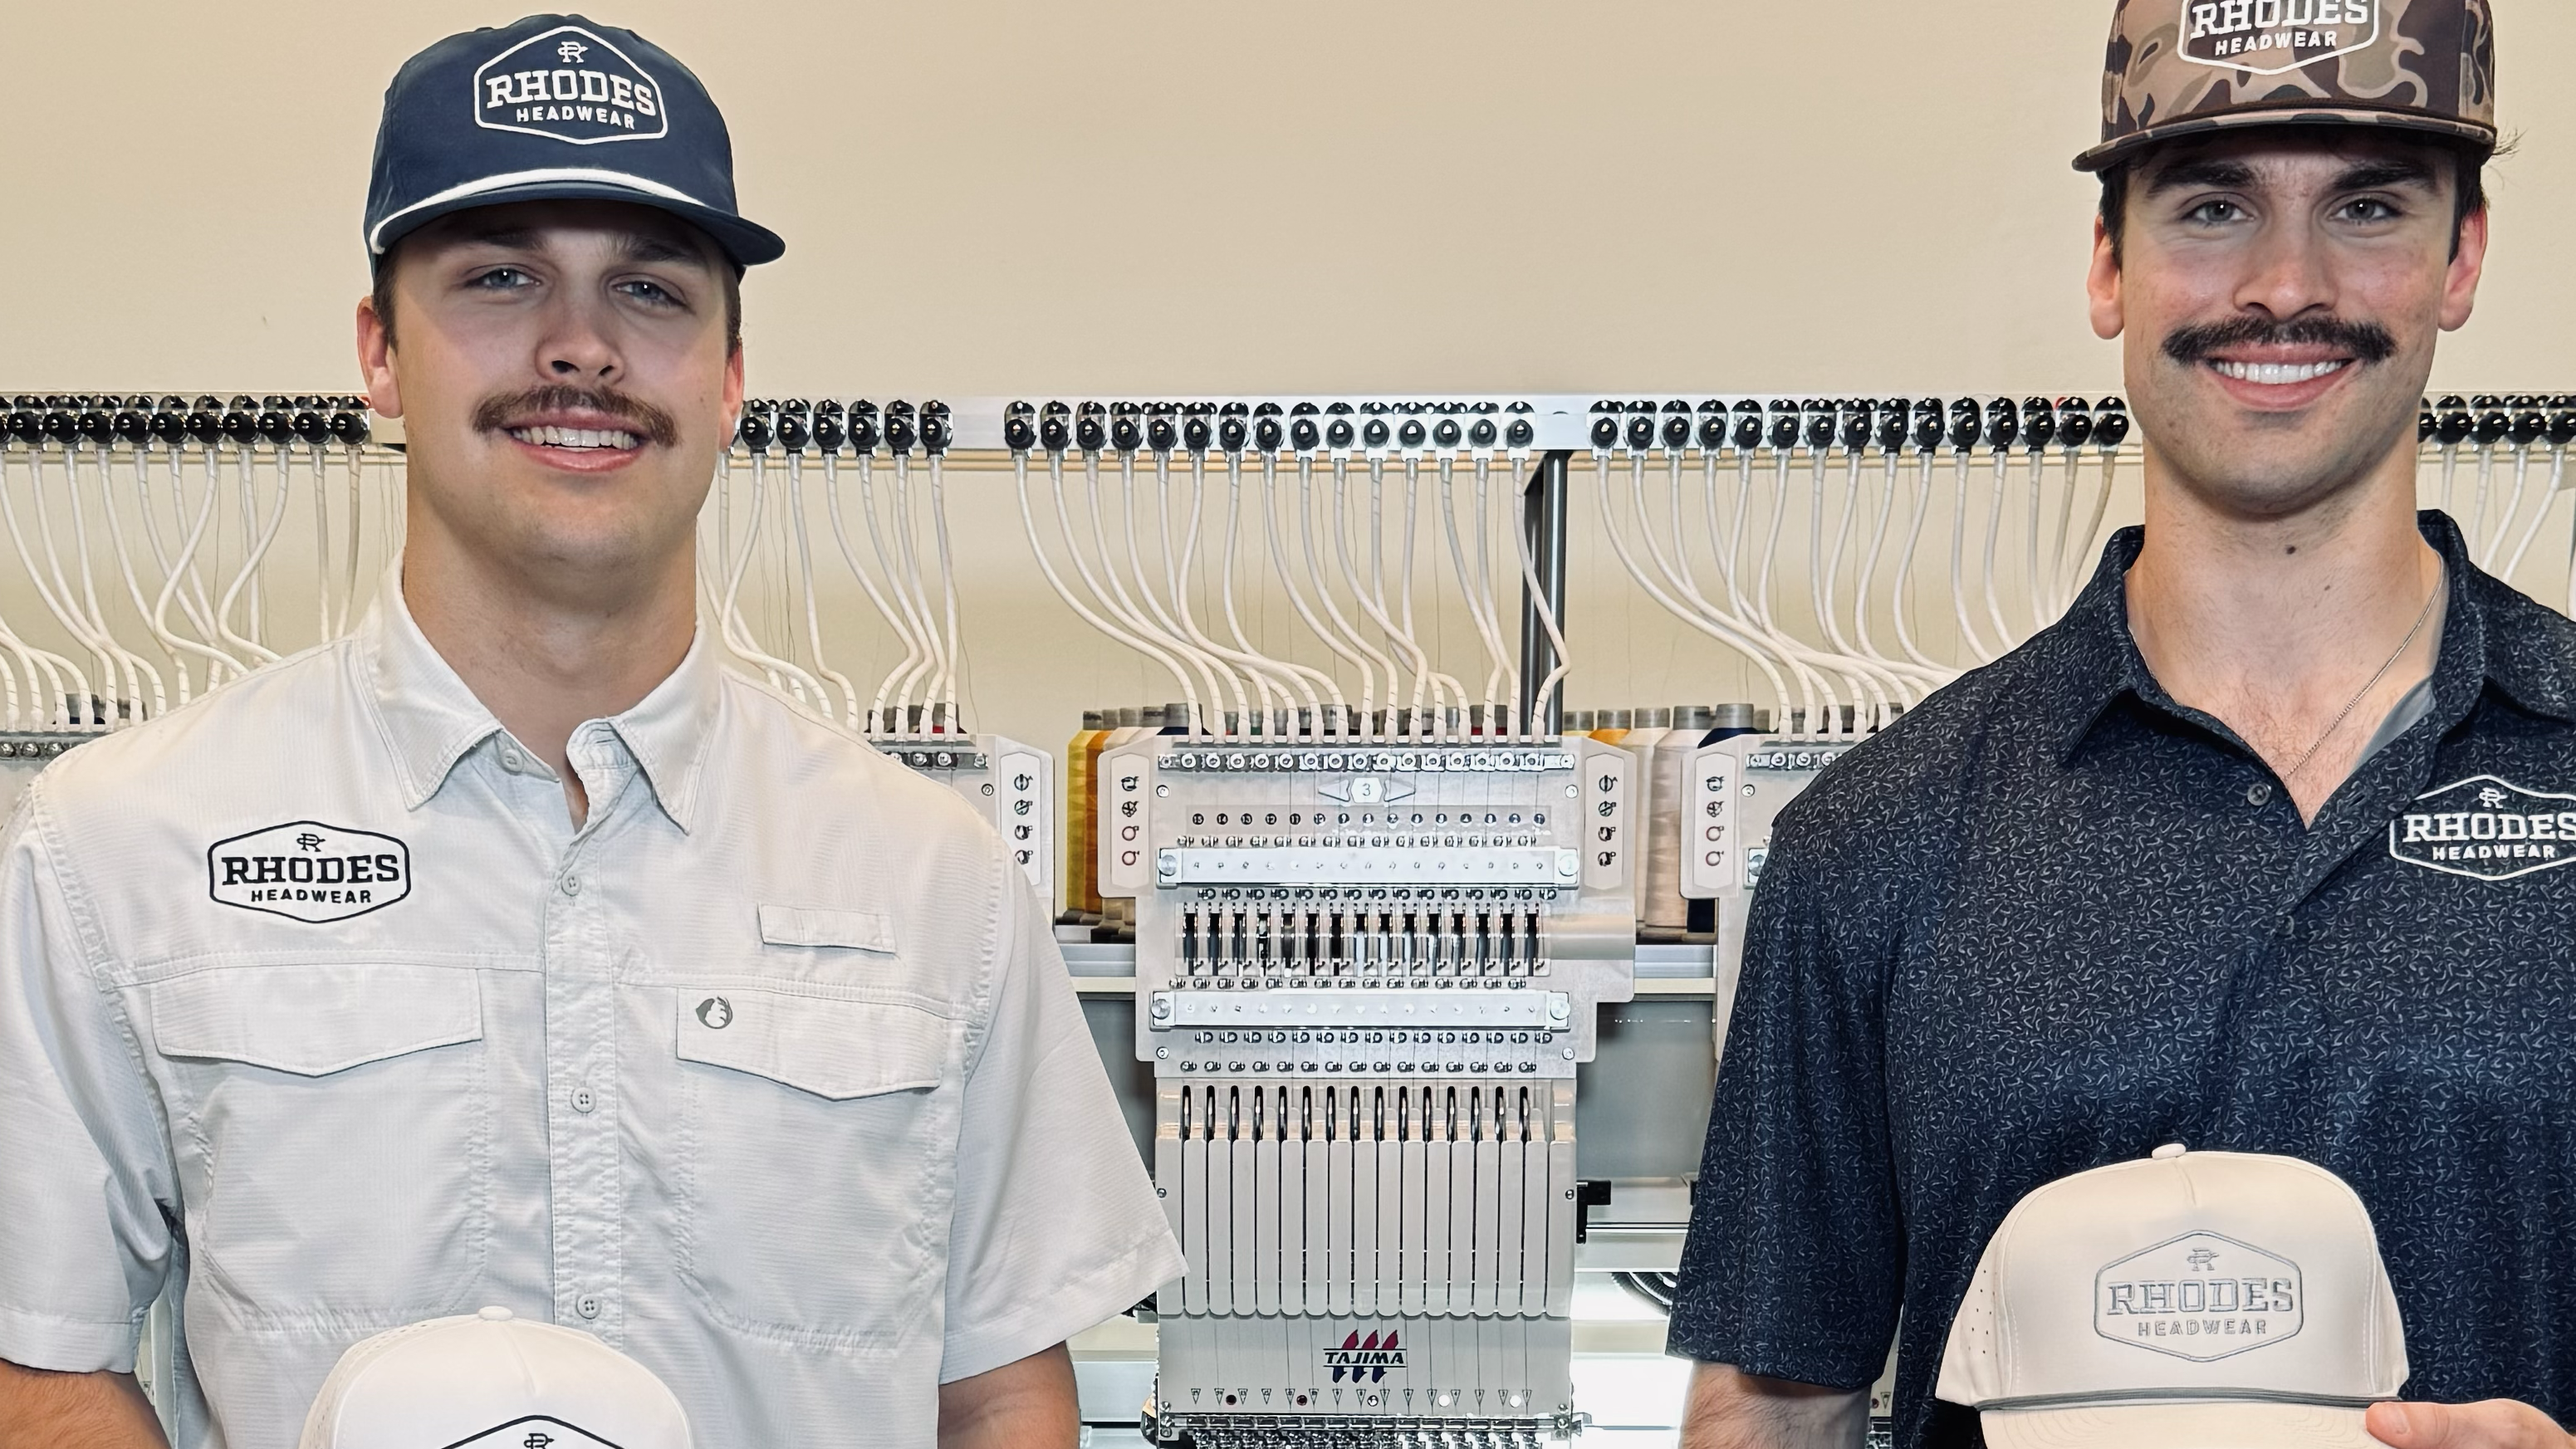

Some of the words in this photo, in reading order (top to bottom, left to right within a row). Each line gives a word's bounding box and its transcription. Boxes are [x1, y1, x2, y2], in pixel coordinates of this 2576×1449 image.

[2190, 0, 2368, 39] RHODES
[2215, 30, 2338, 56] HEADWEAR
[486, 69, 657, 116] RHODES
[516, 105, 635, 130] HEADWEAR
[1362, 783, 1371, 796] 3
[2402, 812, 2576, 843] RHODES
[2432, 844, 2556, 860] HEADWEAR
[221, 854, 399, 885] RHODES
[251, 888, 371, 903] HEADWEAR
[2107, 1277, 2294, 1315] RHODES
[2138, 1319, 2266, 1336] HEADWEAR
[1325, 1352, 1404, 1364] TAJIMA
